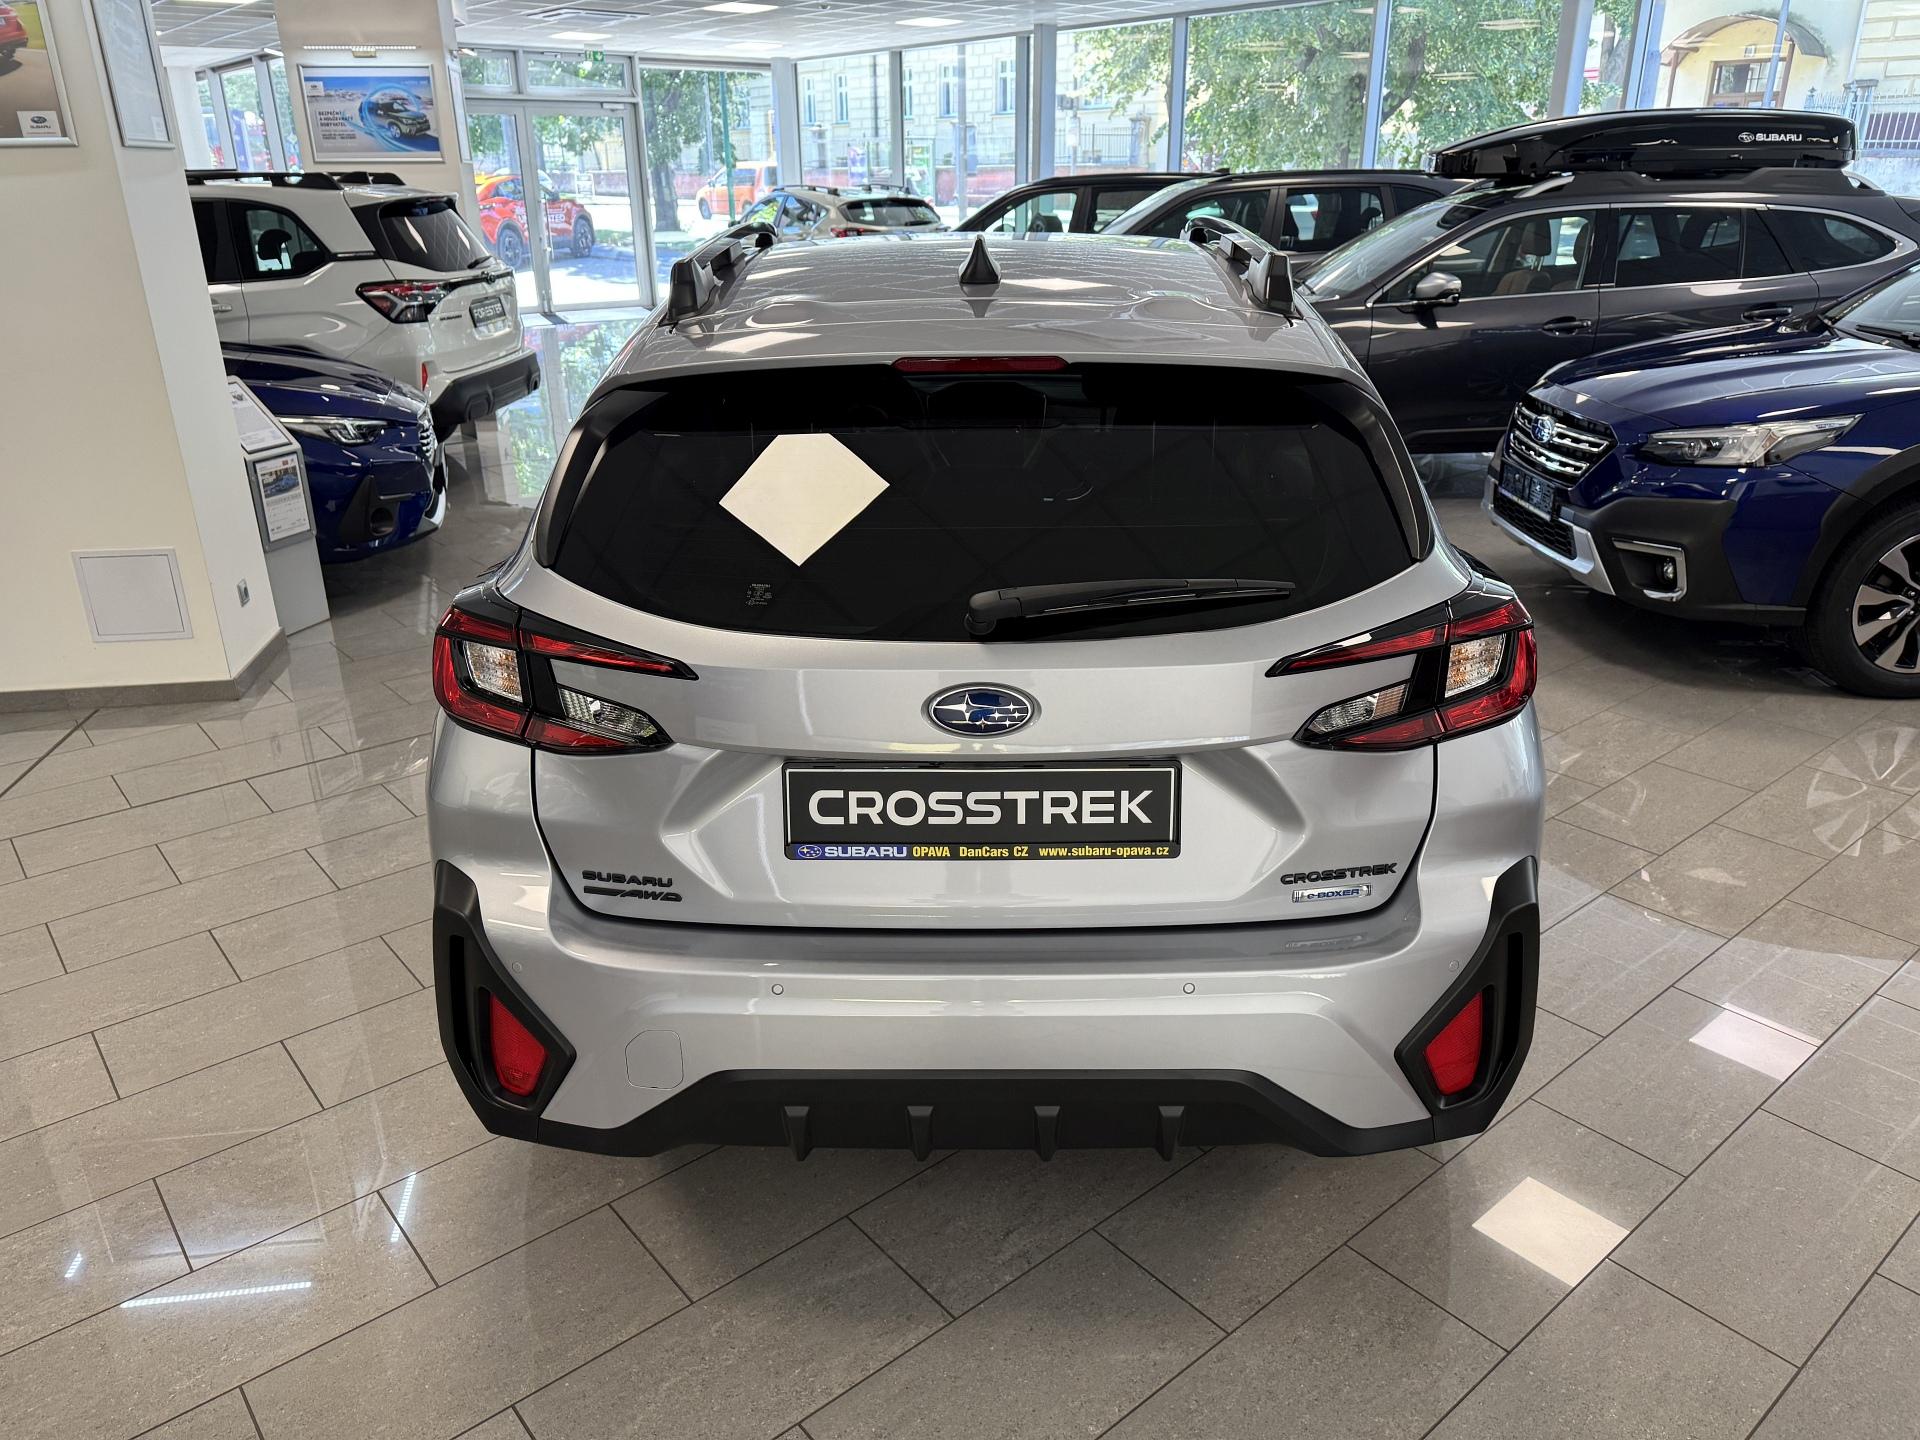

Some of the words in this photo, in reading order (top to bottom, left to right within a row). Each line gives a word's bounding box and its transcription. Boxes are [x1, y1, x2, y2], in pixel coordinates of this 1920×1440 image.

[1755, 133, 1803, 142] SUBARU
[808, 789, 1153, 826] CROSSTREK
[824, 846, 908, 858] SUBARU
[912, 846, 951, 857] OPAVA
[959, 846, 1009, 857] DanCars
[1013, 845, 1029, 857] CZ
[1039, 844, 1169, 858] www.subaru-opava.cz
[582, 869, 673, 888] SUBARU
[1280, 862, 1398, 885] CROSSTREK
[620, 889, 683, 902] AWD
[1307, 888, 1360, 900] e-BOXER
